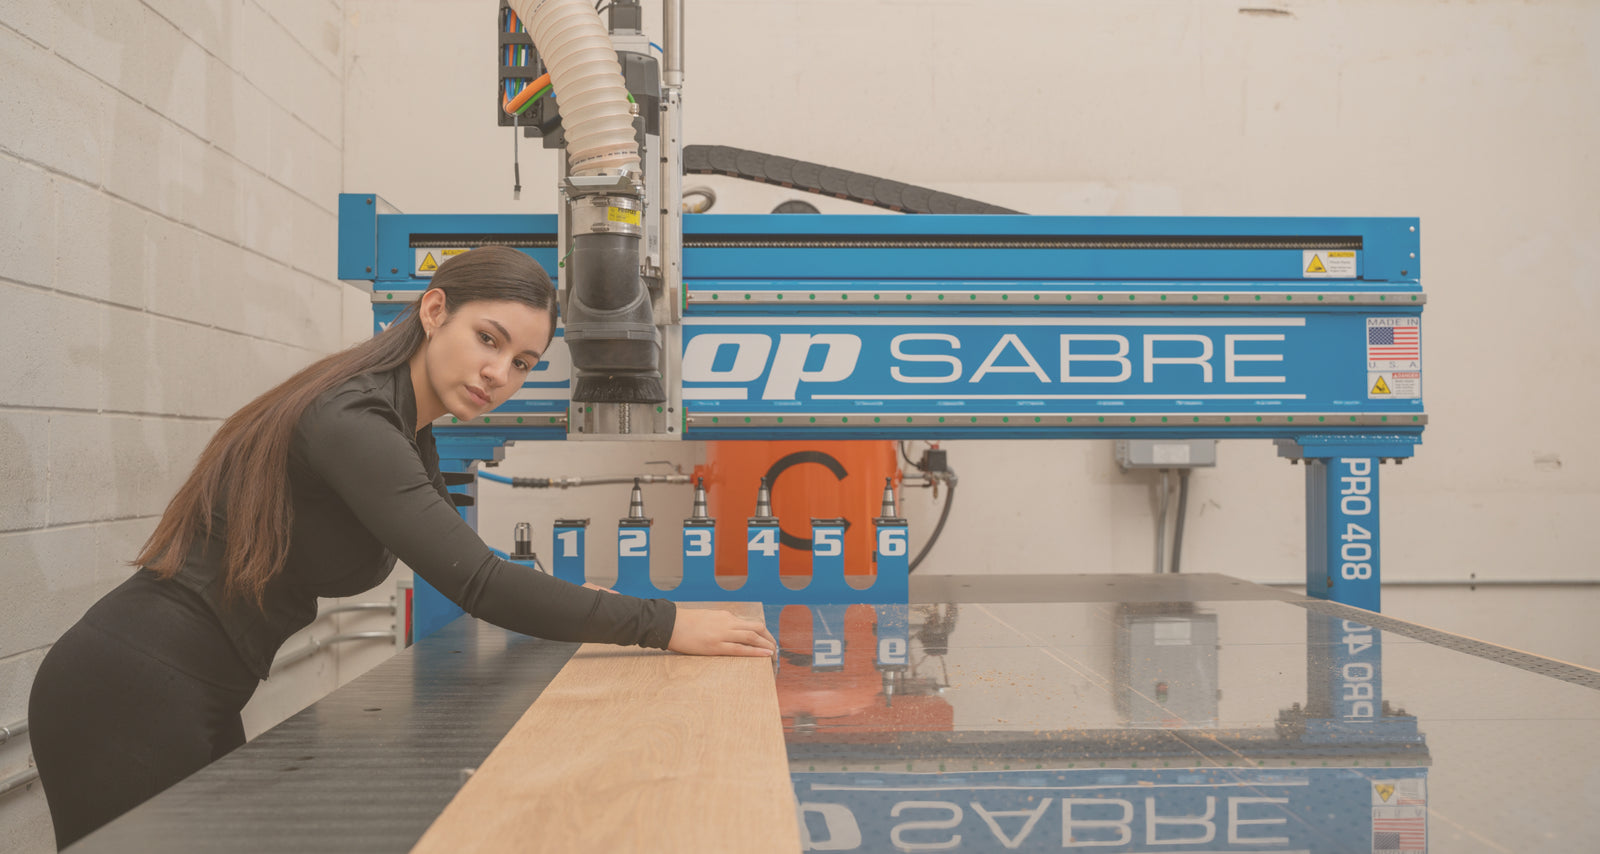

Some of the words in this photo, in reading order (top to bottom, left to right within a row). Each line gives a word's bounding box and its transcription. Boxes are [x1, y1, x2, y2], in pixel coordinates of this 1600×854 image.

[890, 333, 1286, 384] SABRE
[1341, 458, 1372, 516] PRO
[557, 530, 578, 557] 1
[619, 530, 648, 557] 2
[685, 529, 712, 557] 3
[747, 529, 779, 557] 4
[814, 529, 842, 557] 5
[879, 529, 907, 557] 6
[1341, 523, 1372, 580] 408
